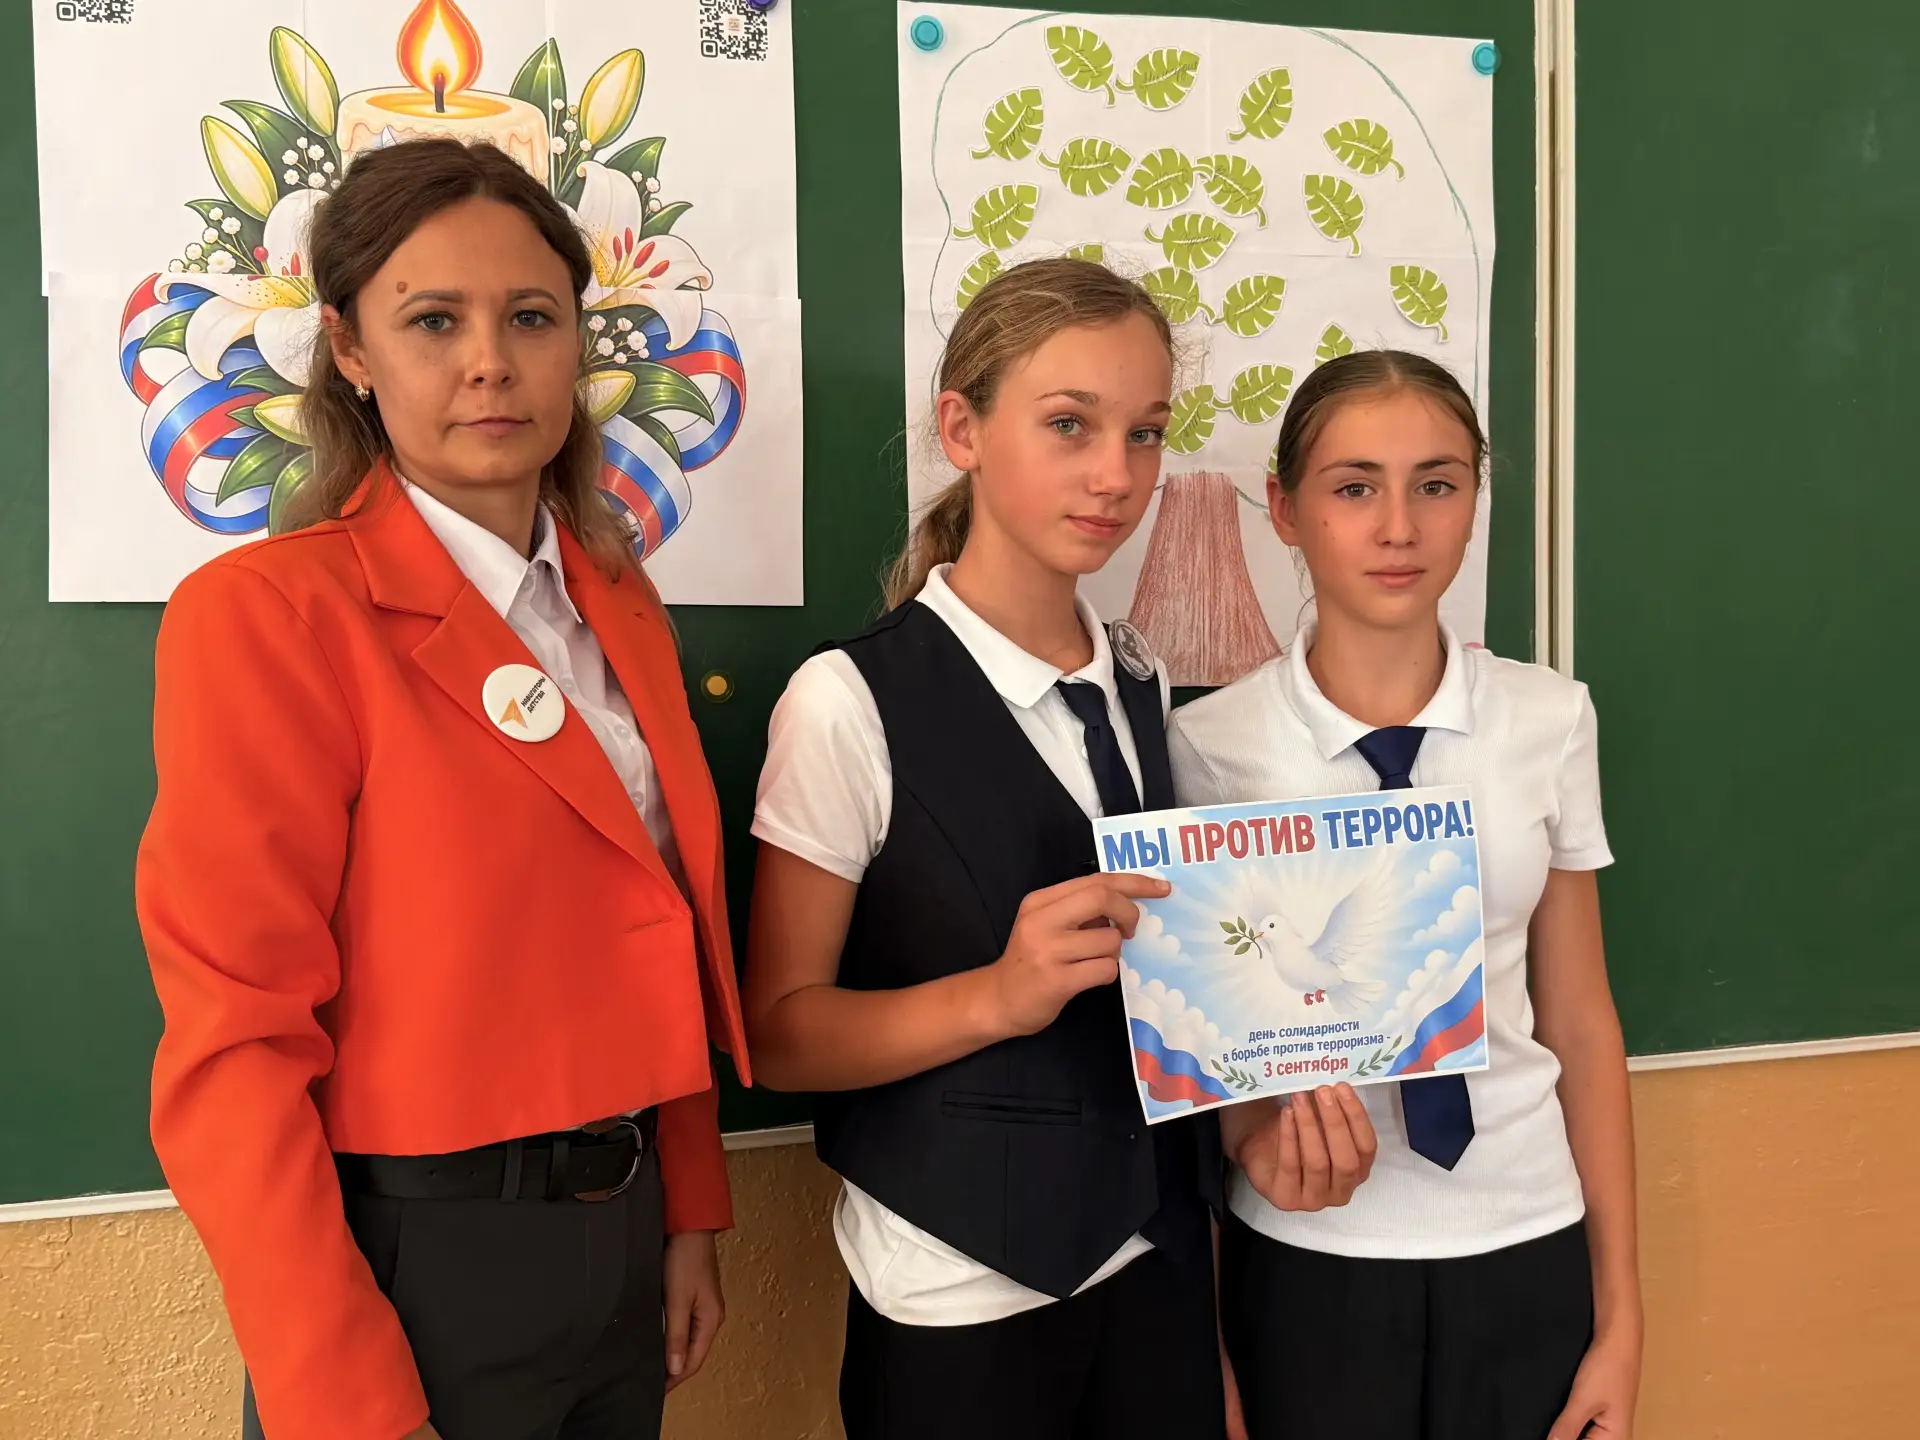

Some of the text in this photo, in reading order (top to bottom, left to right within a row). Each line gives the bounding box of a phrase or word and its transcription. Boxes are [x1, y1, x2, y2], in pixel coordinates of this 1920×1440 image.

[1102, 799, 1475, 872] МЫ ПРОТИВ ТЕРРОРА!
[1248, 1020, 1360, 1043] день солидарности
[1222, 1052, 1229, 1063] в
[1231, 1044, 1270, 1062] борьбе
[1273, 1042, 1314, 1057] против
[1317, 1034, 1384, 1053] терроризма
[1263, 1055, 1349, 1078] 3 сентября
